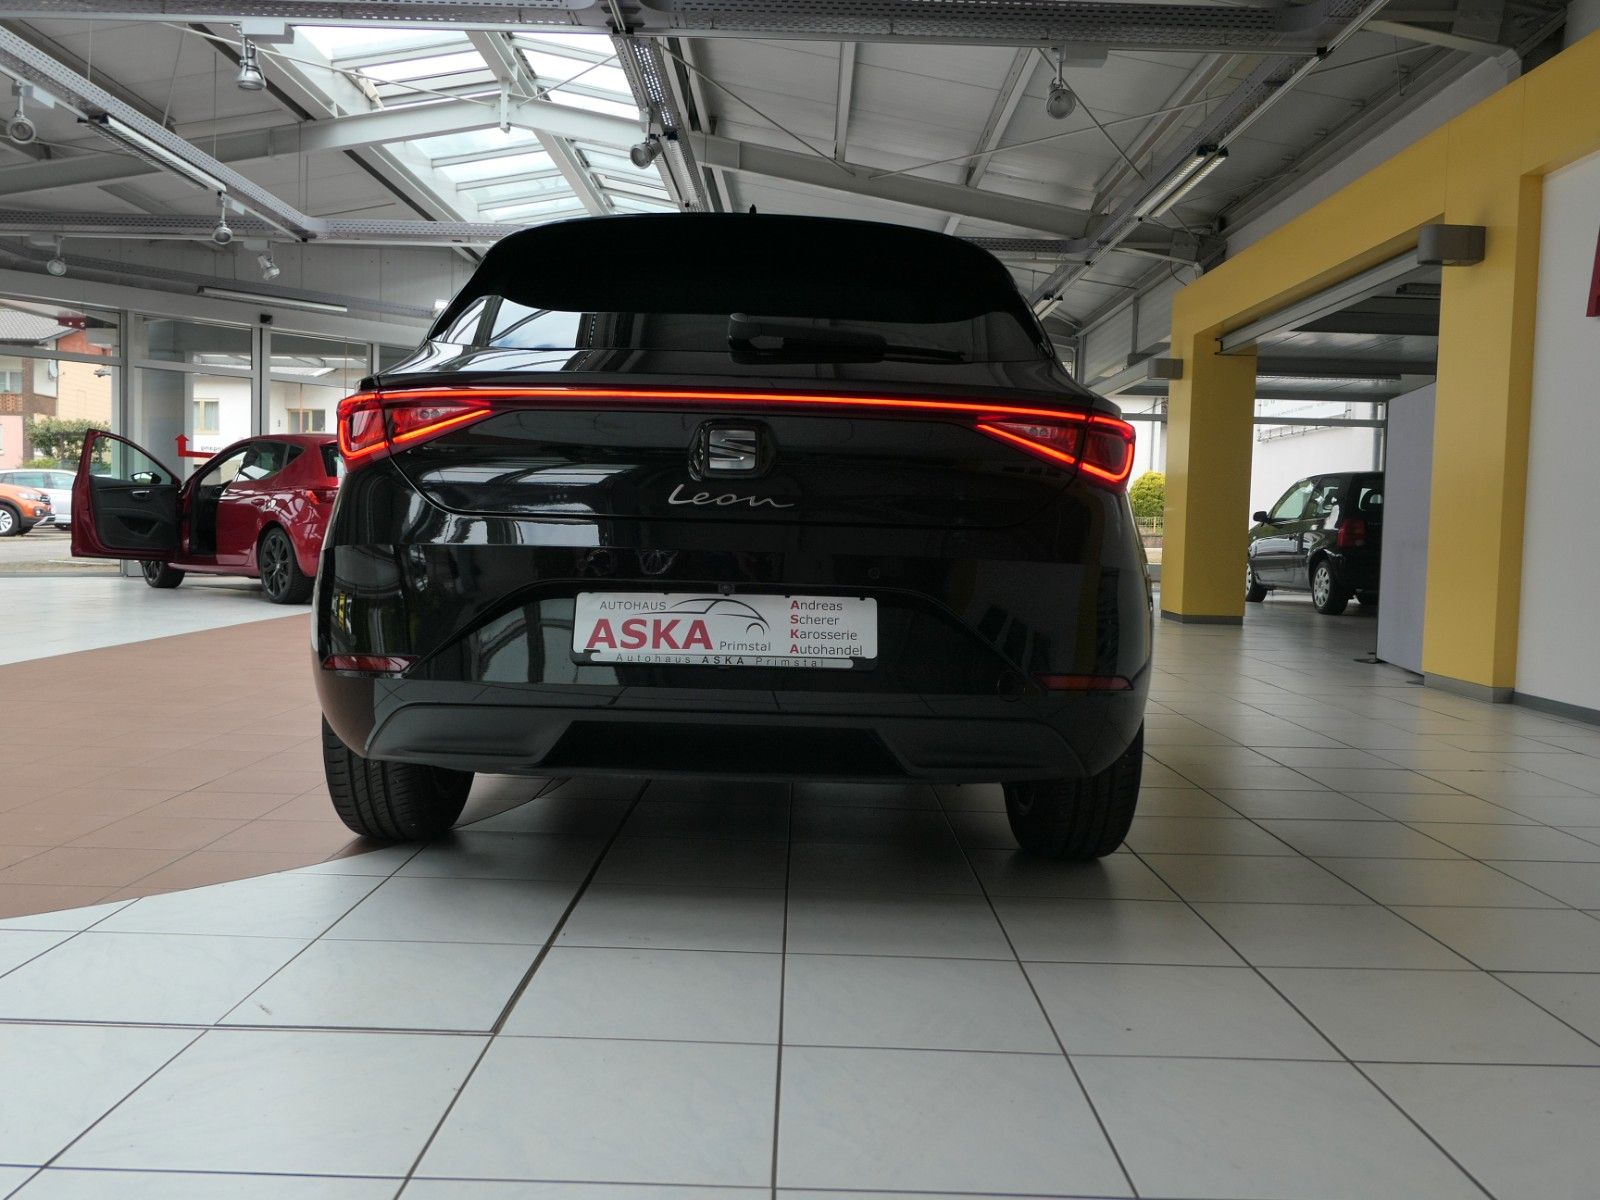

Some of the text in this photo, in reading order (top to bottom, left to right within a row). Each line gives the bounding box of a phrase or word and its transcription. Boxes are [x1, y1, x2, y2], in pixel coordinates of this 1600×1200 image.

[668, 484, 795, 508] Leon
[600, 601, 667, 611] AUTOHAUS
[790, 600, 843, 611] Andreas
[790, 614, 840, 625] Scherer
[586, 618, 713, 650] ASKA
[790, 629, 858, 641] Karosserie
[719, 641, 771, 652] Primstal
[789, 644, 863, 656] Autohandel
[616, 653, 824, 667] Autohaus ASKA Primstal
